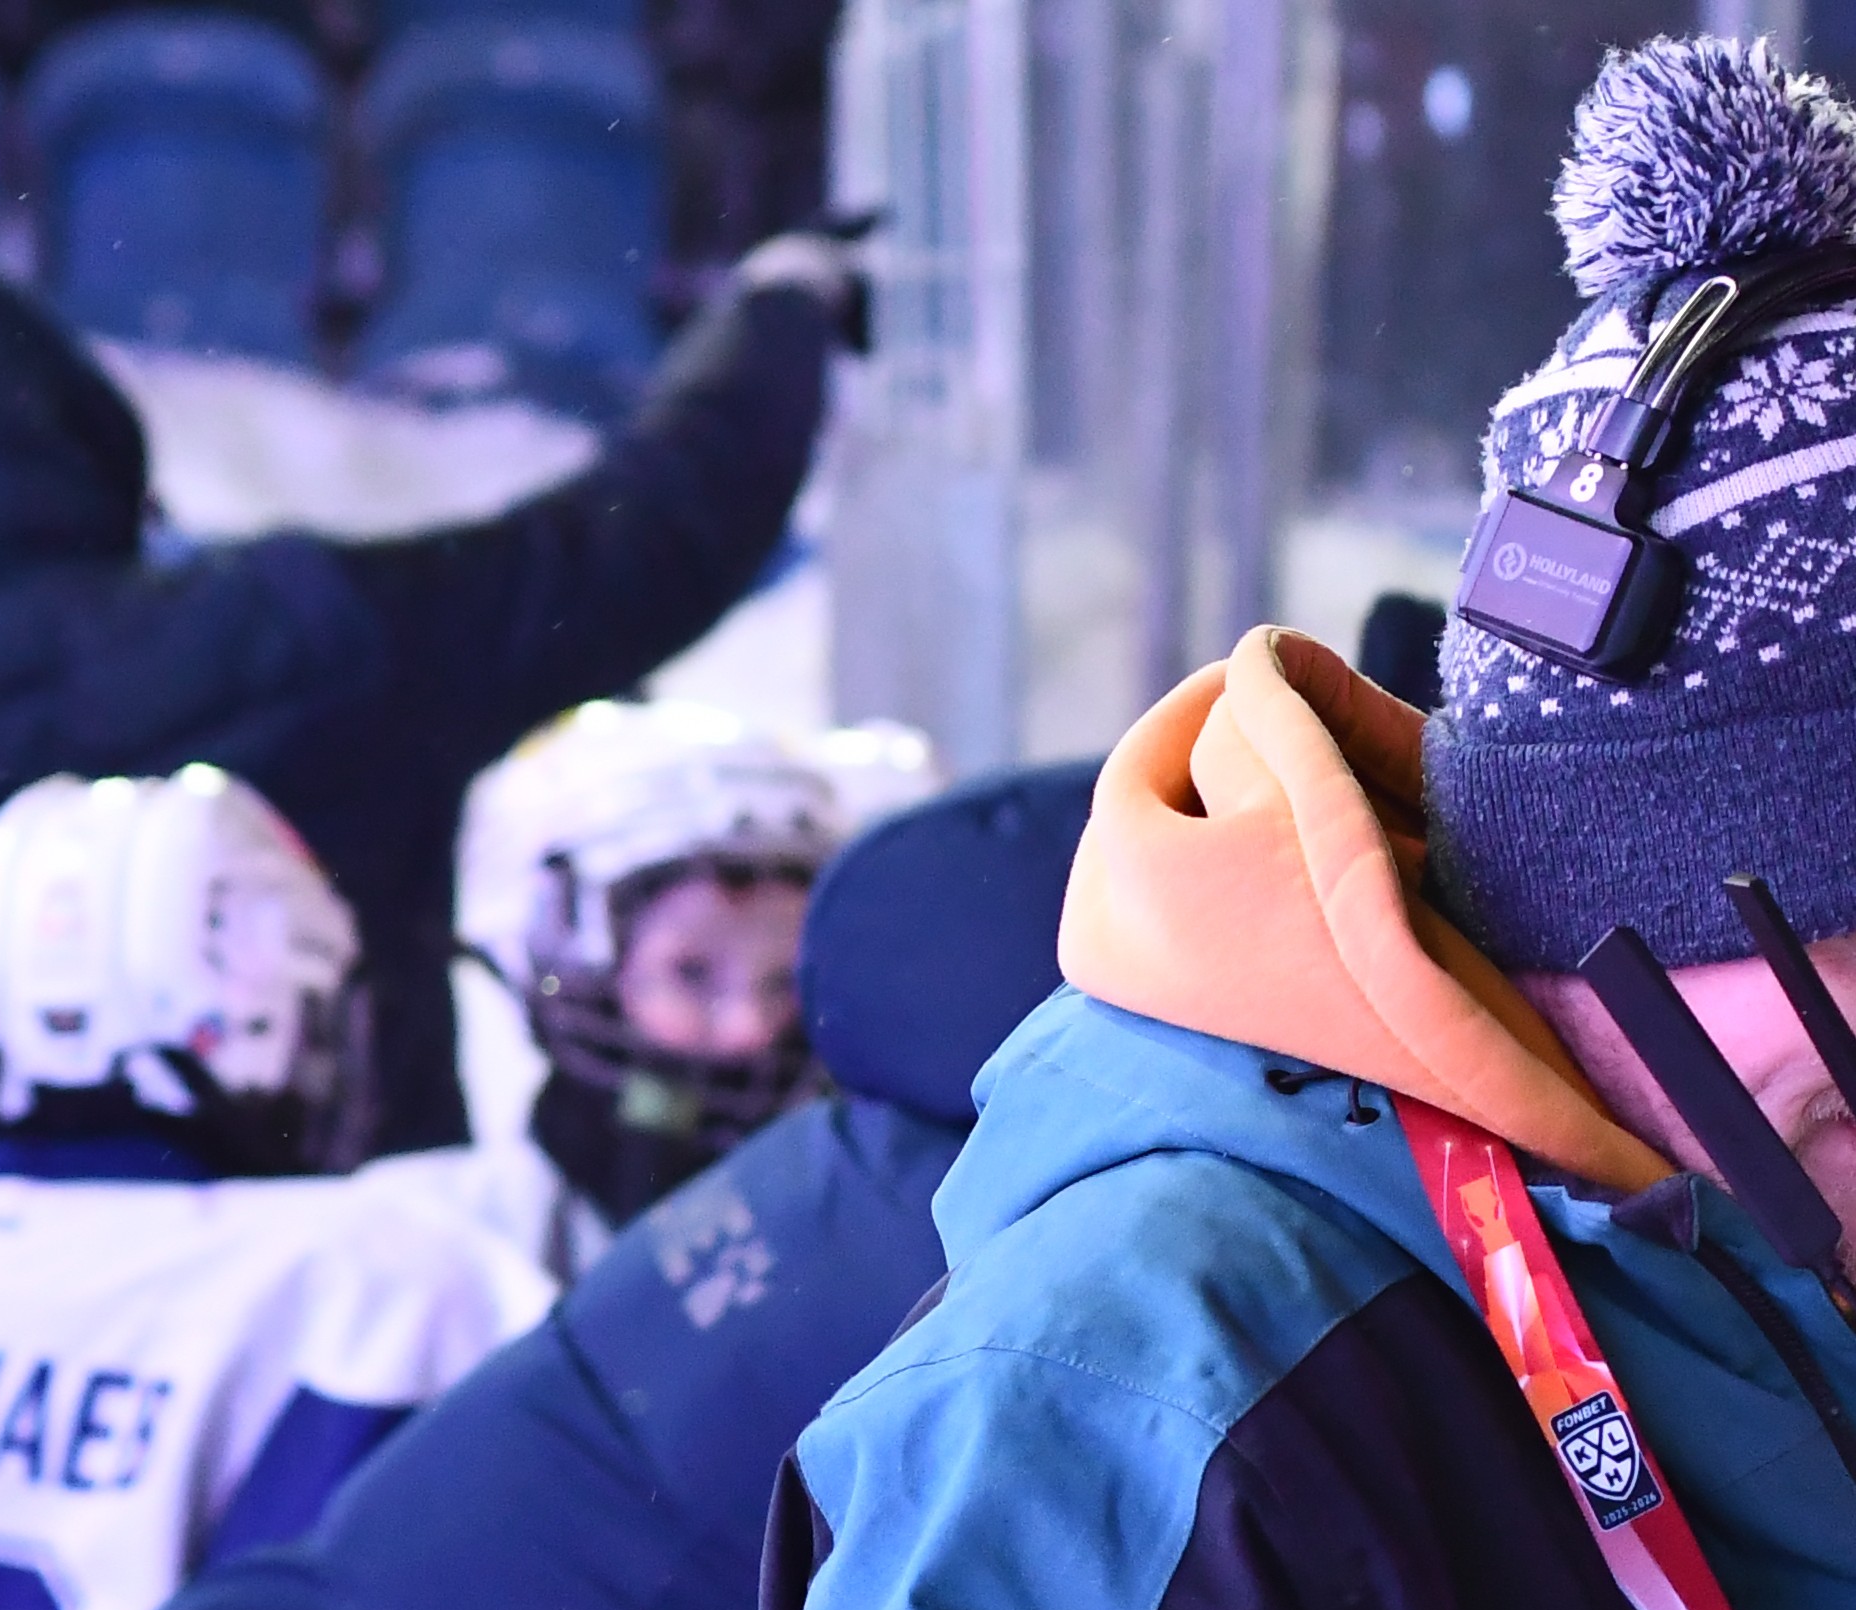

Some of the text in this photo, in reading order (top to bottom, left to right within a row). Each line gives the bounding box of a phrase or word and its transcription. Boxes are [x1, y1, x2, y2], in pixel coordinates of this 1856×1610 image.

[1569, 462, 1604, 502] 8
[1528, 554, 1612, 595] HOLLYLAND
[1556, 1396, 1608, 1433] FONBET
[1602, 1491, 1657, 1526] 2025-2026
